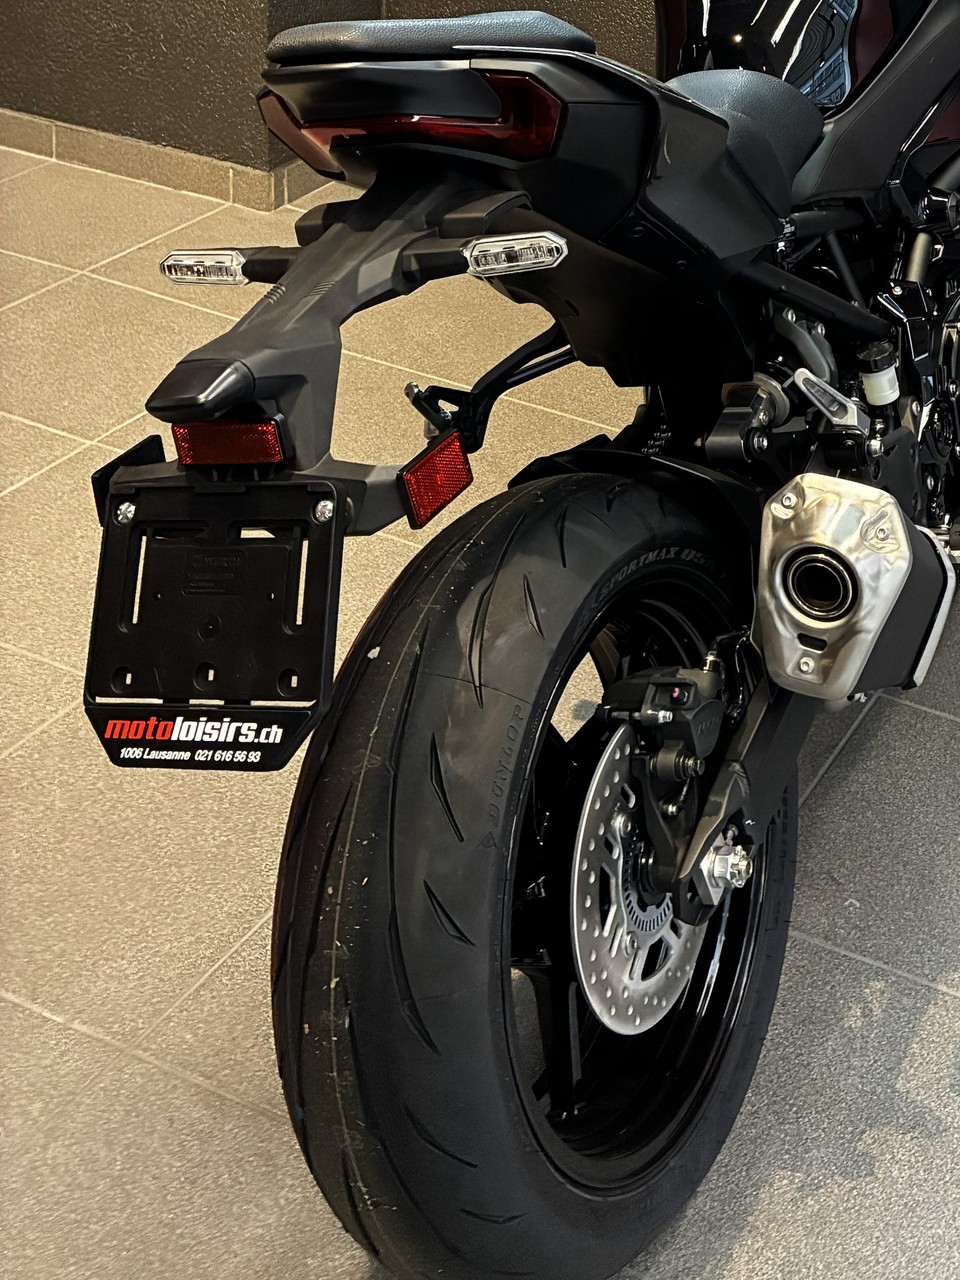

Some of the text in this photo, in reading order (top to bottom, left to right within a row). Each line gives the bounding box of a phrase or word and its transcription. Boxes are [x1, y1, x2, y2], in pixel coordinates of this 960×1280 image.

[104, 716, 283, 744] motoloisirs.ch
[120, 747, 261, 763] 1006 Lausanne 021 616 56 93
